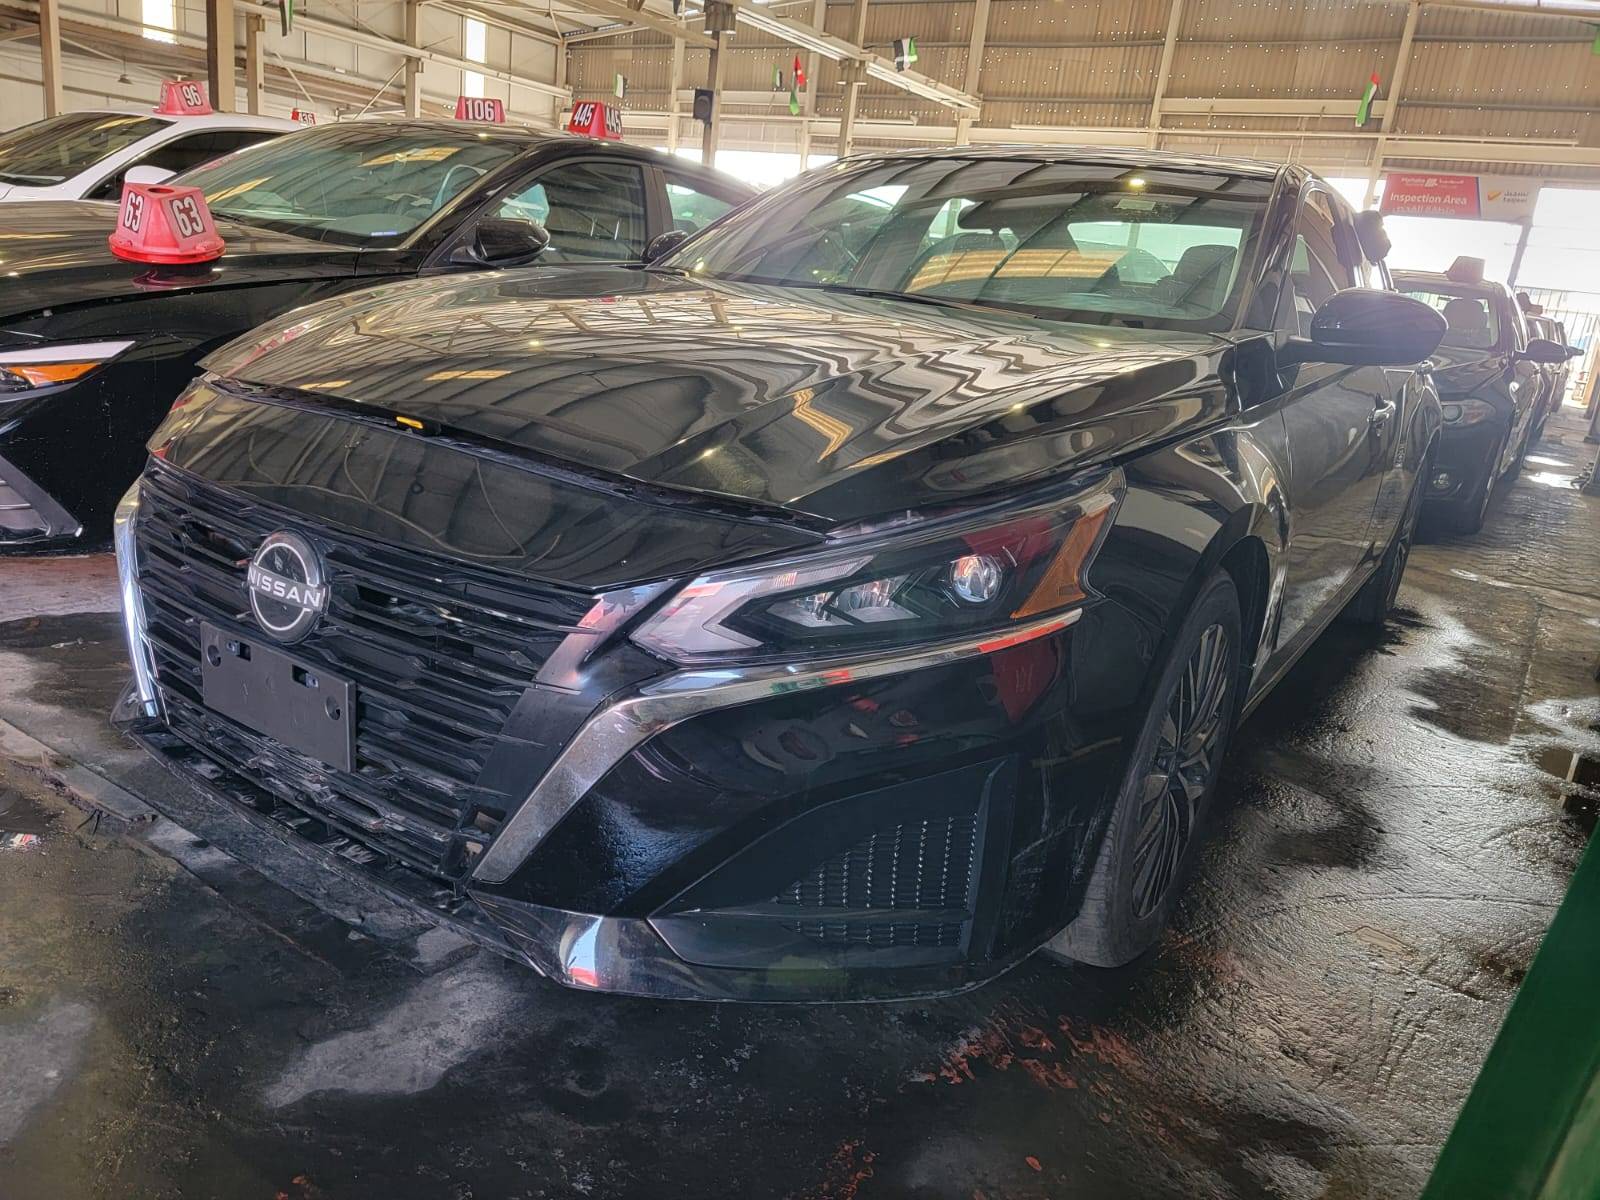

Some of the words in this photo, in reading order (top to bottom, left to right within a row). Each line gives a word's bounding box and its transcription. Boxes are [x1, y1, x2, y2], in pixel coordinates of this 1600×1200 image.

[183, 84, 201, 106] 96
[465, 100, 495, 121] 106
[573, 103, 594, 126] 445
[605, 107, 622, 134] 445
[1390, 192, 1442, 204] Inspection
[1442, 194, 1468, 205] Area
[124, 191, 144, 232] 63
[172, 196, 204, 237] 63
[248, 566, 321, 607] NISSAN
